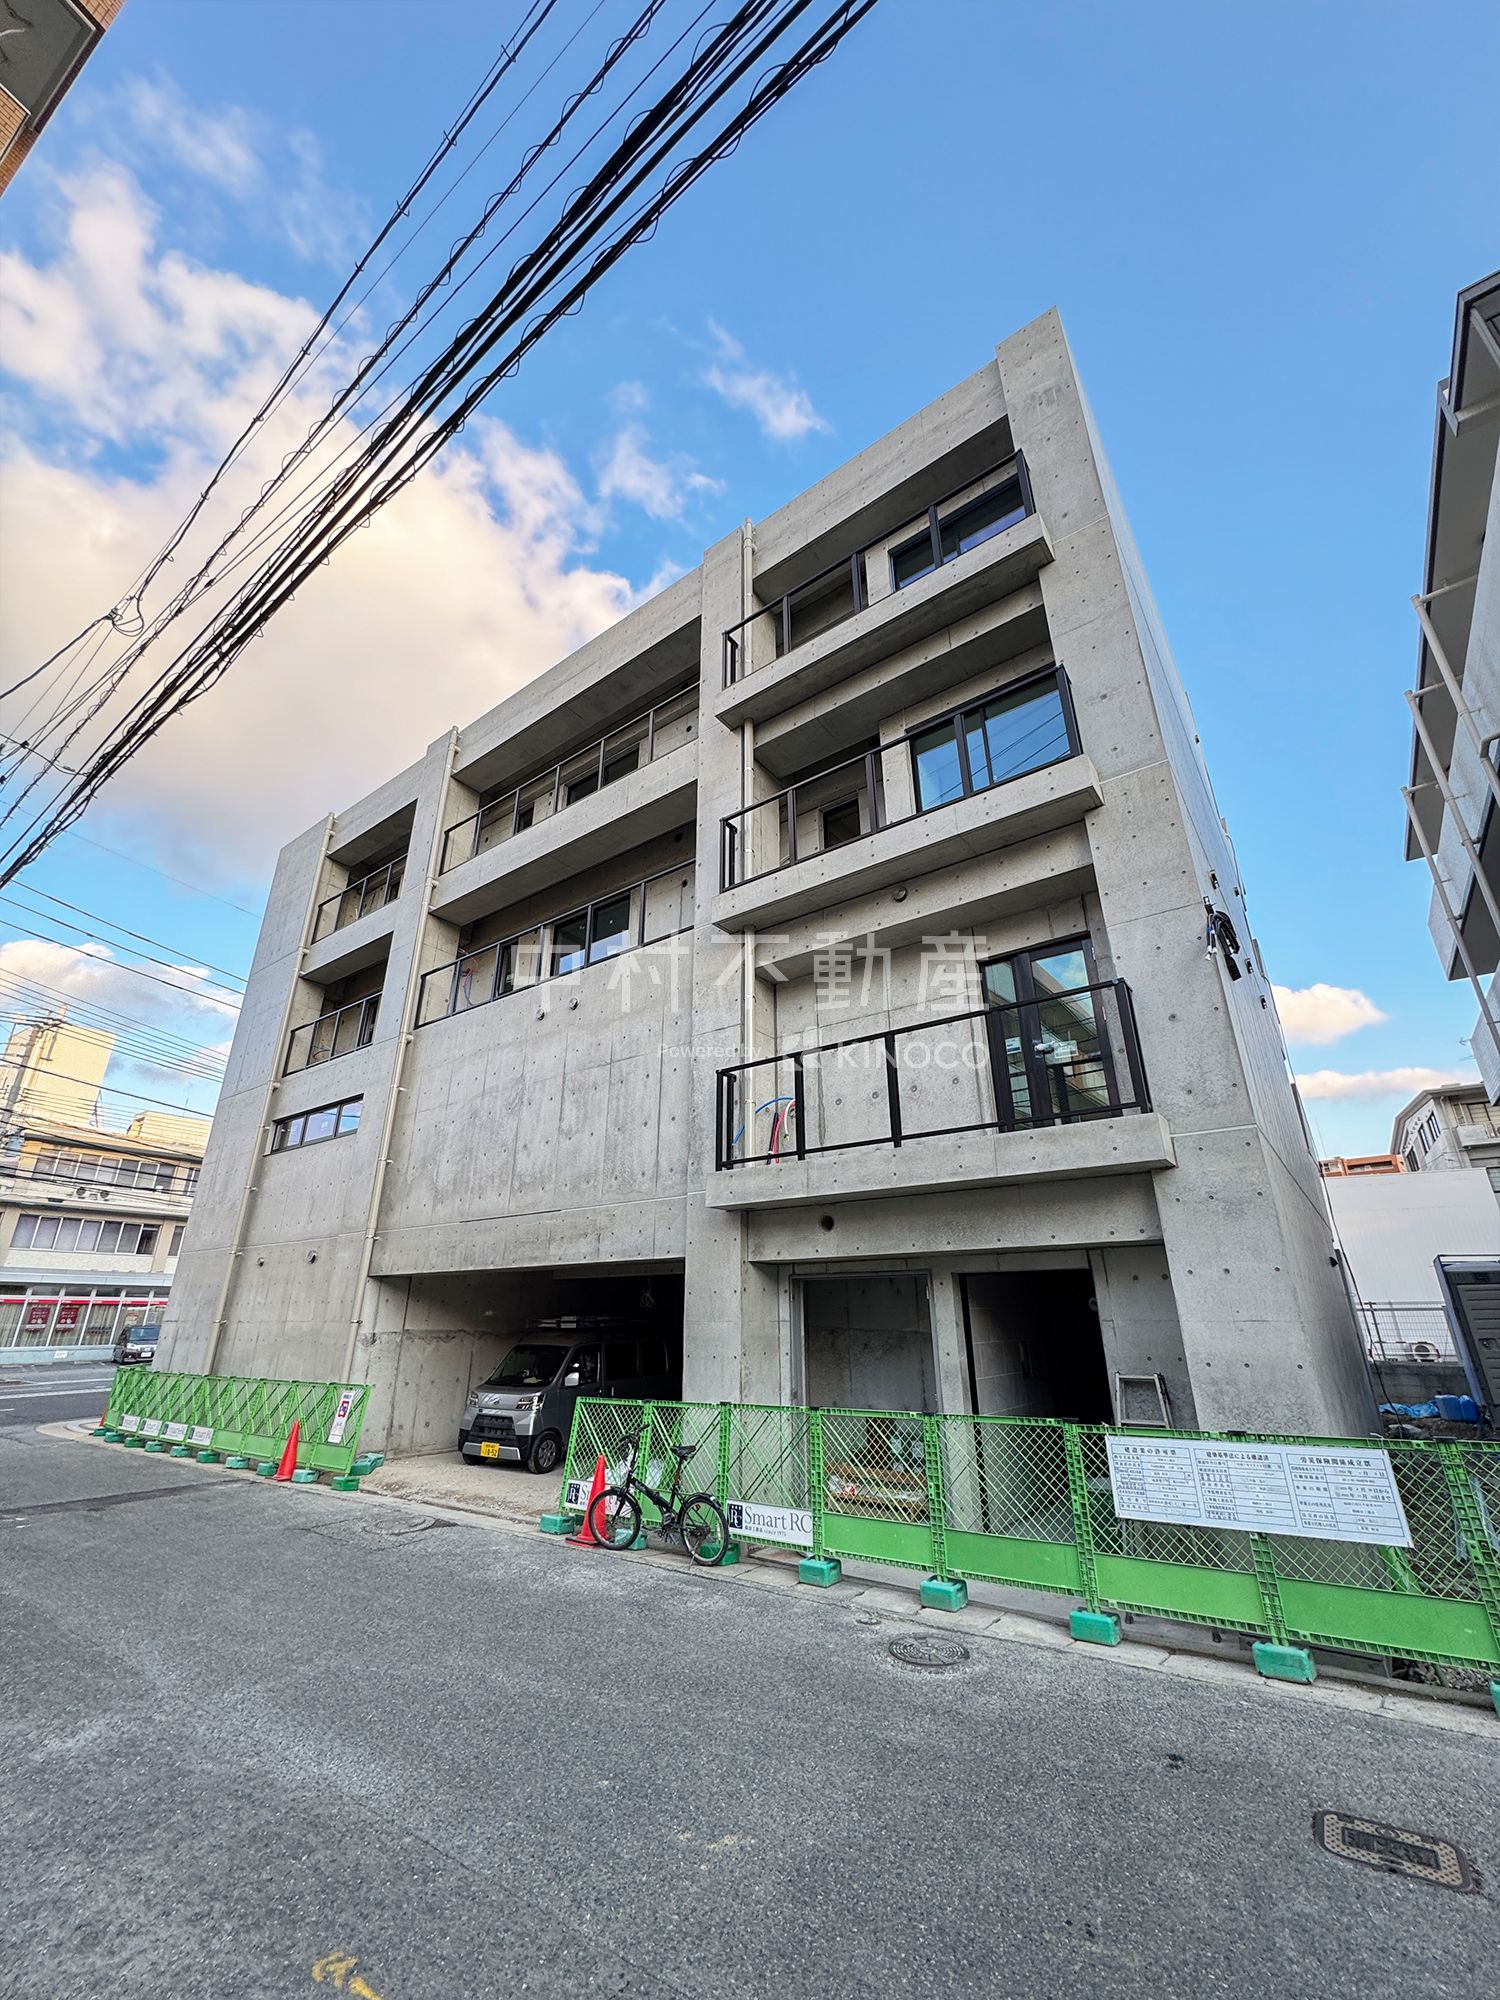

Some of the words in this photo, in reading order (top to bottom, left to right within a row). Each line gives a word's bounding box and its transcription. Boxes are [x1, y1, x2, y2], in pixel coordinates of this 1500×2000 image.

[1300, 1456, 1371, 1467] 労災保険関係成立票
[744, 1505, 788, 1530] Smart
[789, 1512, 813, 1534] RC
